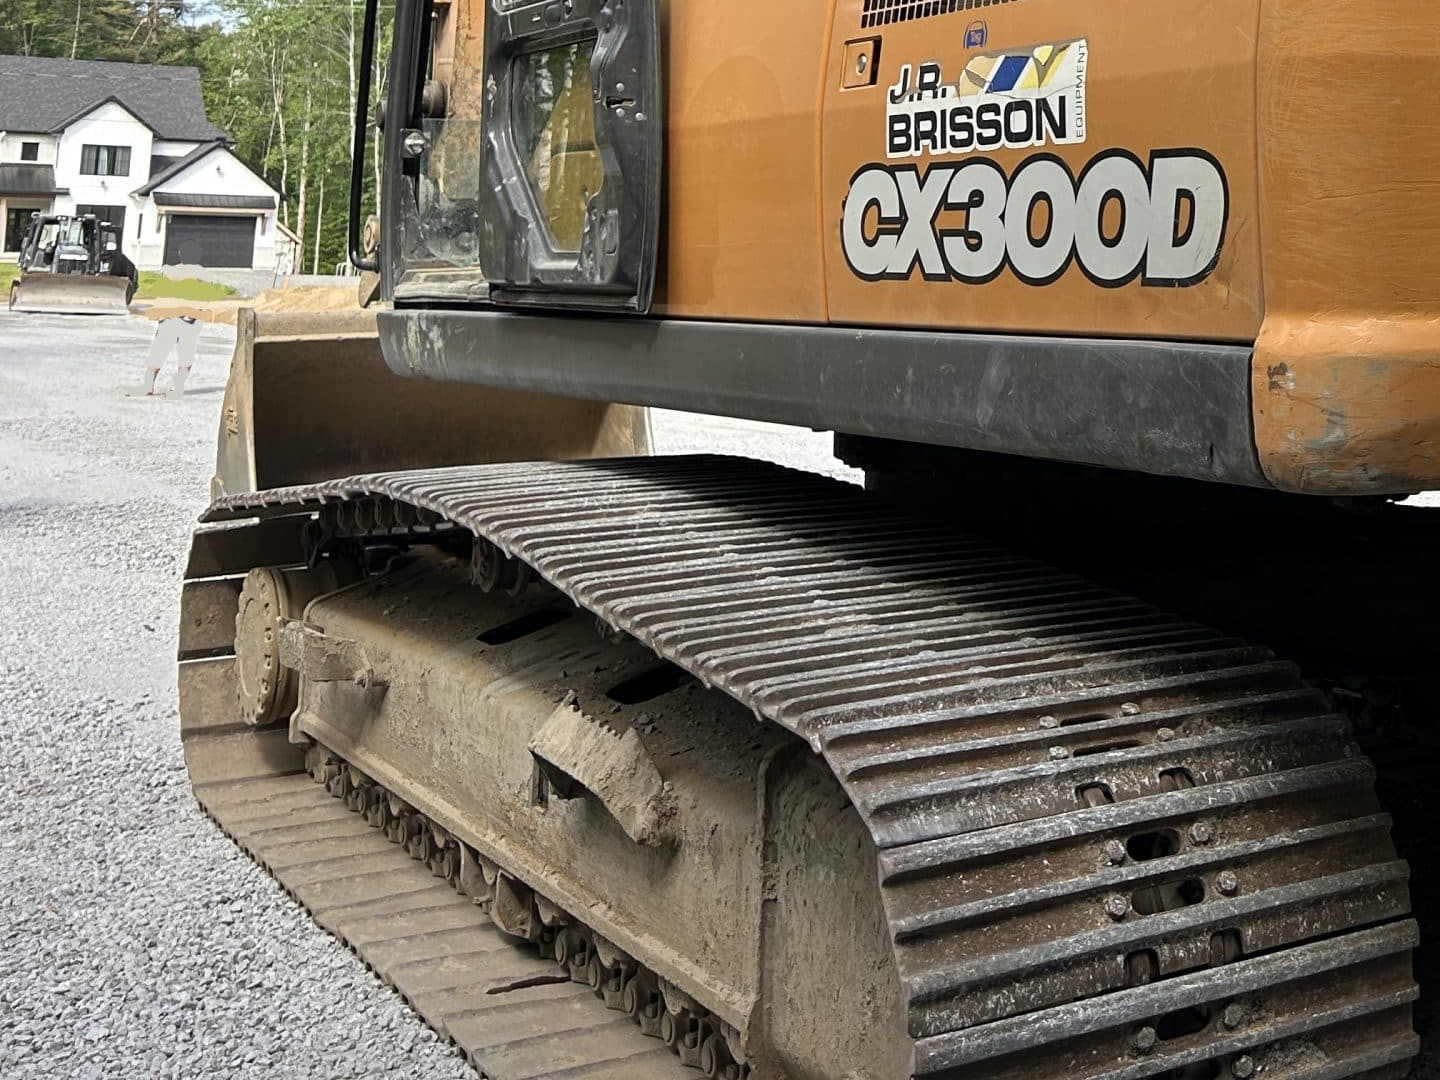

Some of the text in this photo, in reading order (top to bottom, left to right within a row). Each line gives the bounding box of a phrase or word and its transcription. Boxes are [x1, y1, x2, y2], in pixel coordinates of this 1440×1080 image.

[889, 63, 947, 105] J.R.
[1075, 43, 1086, 138] EQUIPMENT
[889, 95, 1067, 153] BRISSON
[841, 148, 1230, 288] CX300D
